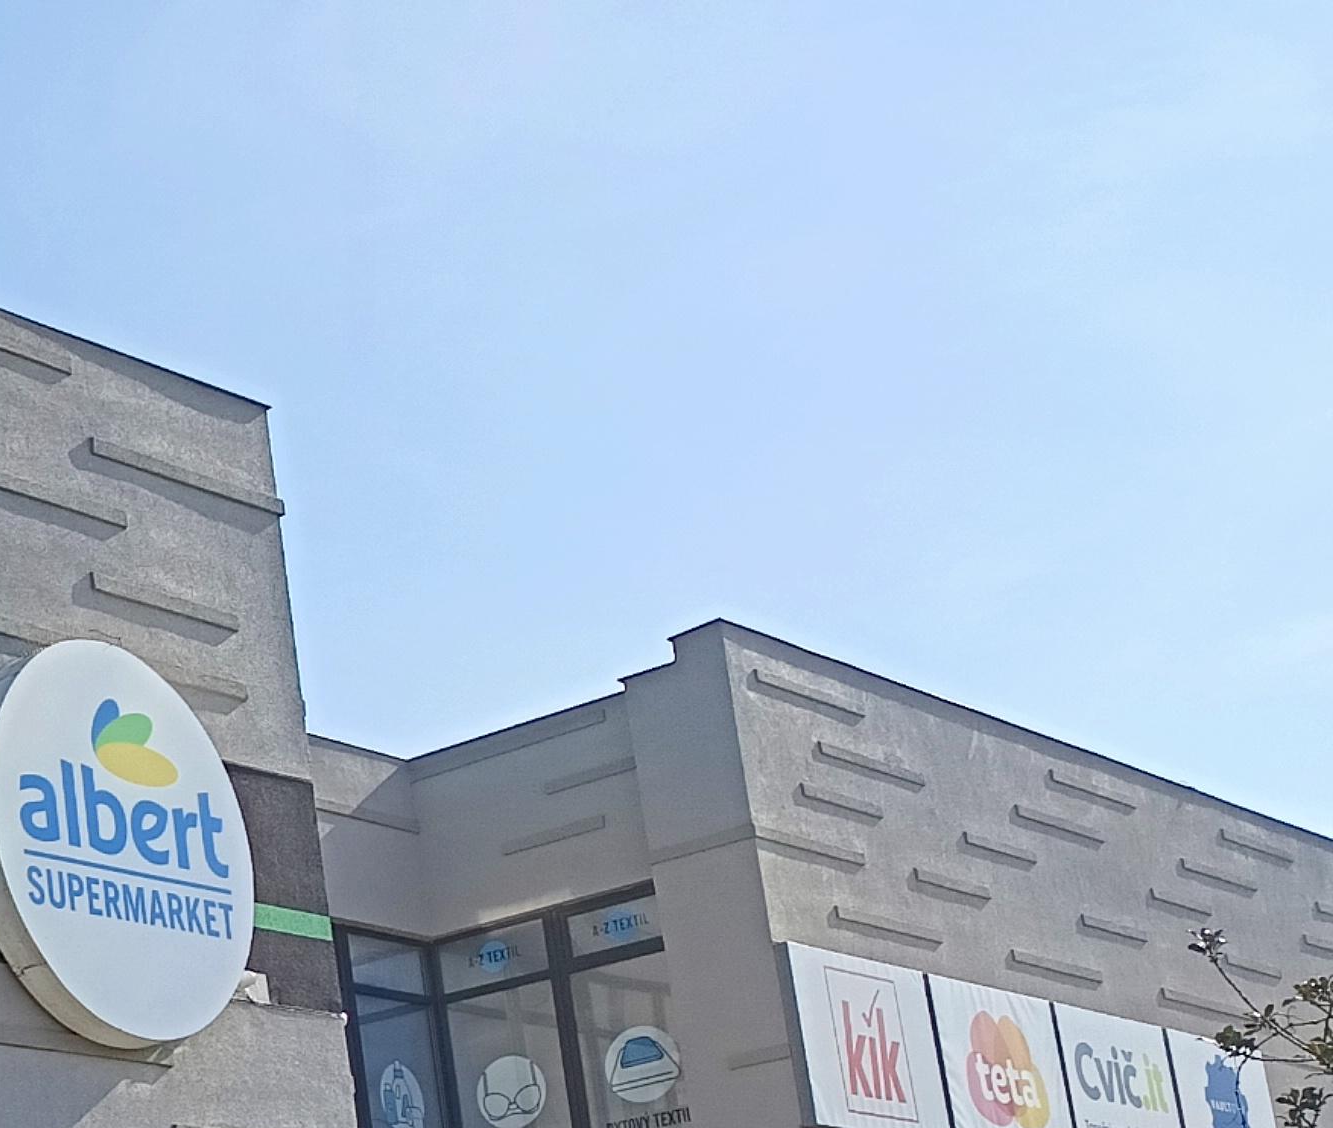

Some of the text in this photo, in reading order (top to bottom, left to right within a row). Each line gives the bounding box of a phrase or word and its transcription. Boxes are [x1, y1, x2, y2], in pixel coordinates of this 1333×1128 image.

[19, 759, 229, 878] albert
[26, 865, 234, 940] SUPERMARKET
[612, 913, 650, 934] TEXTIL
[842, 989, 907, 1104] kik
[976, 1052, 1042, 1109] teta
[1074, 1041, 1169, 1114] Cvič.it
